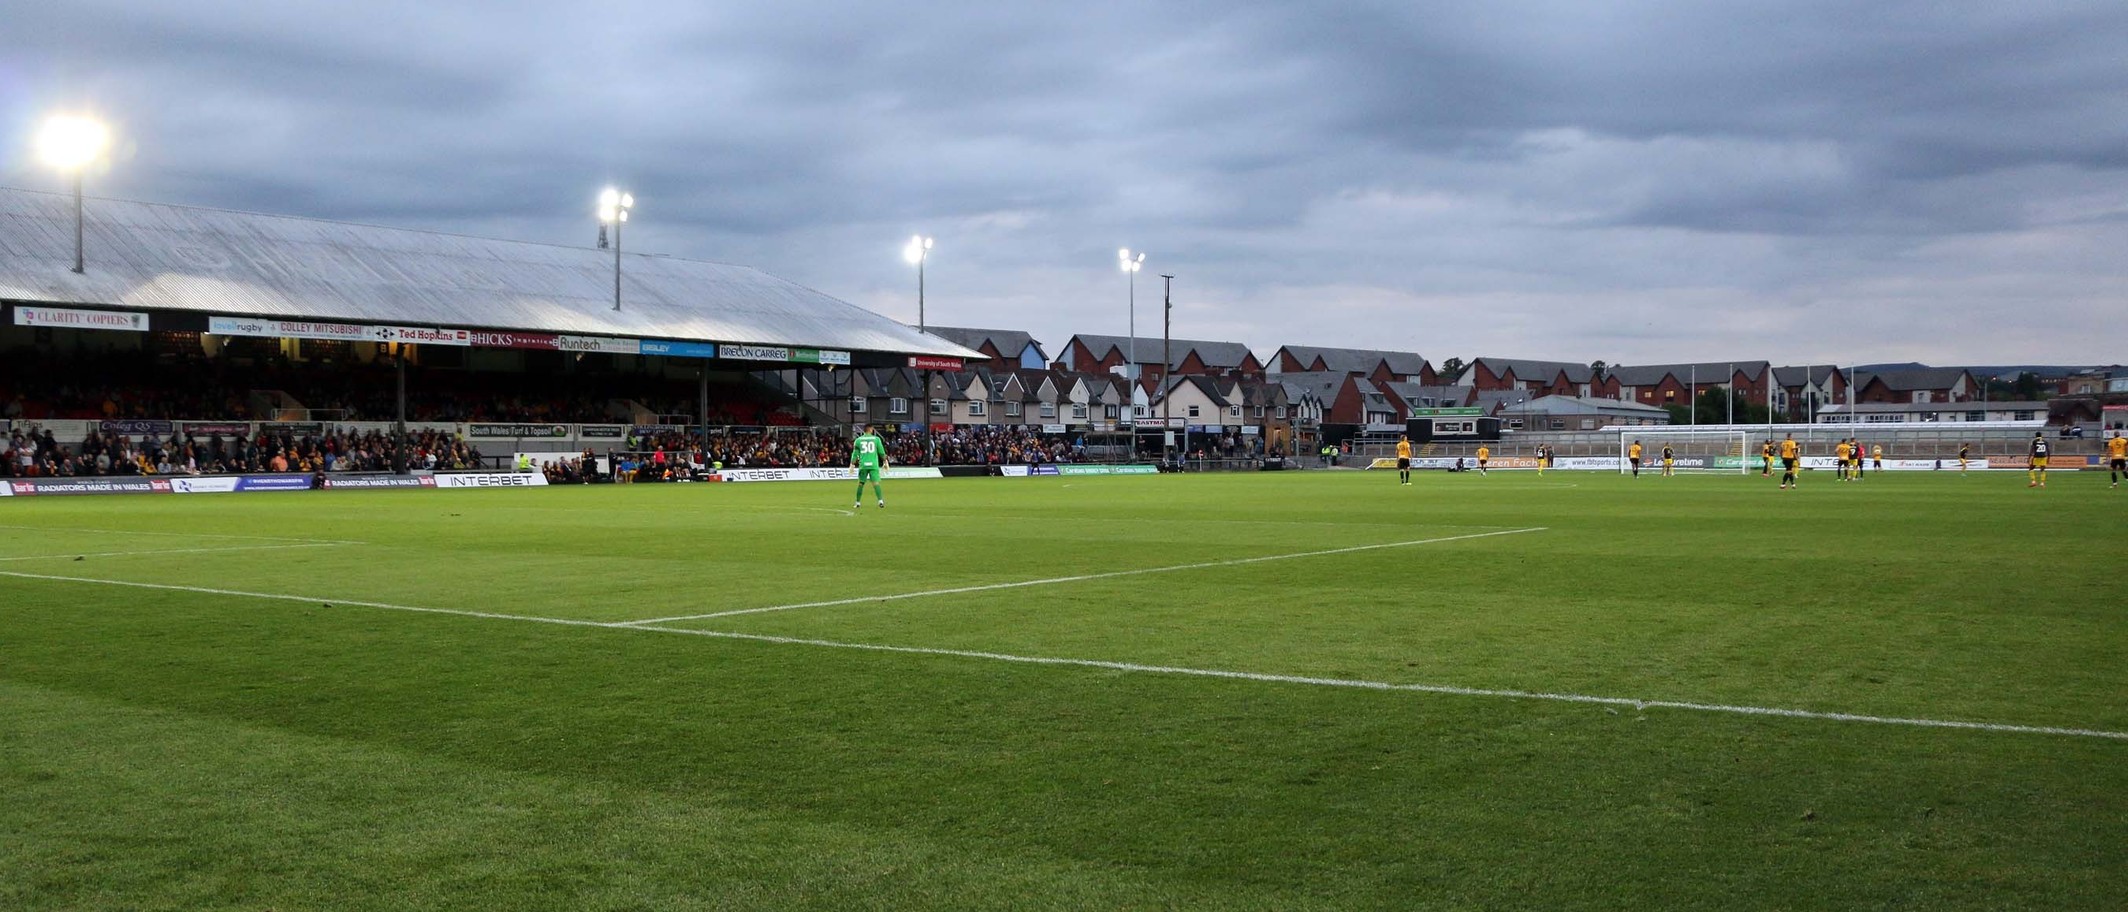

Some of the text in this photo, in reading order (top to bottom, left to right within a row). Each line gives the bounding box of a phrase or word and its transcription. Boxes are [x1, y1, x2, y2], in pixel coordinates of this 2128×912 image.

[37, 310, 129, 325] CLARITY COPIERS
[280, 322, 362, 335] COLLEY MITSUBISHI
[398, 329, 453, 341] Ted Hopkins
[476, 333, 513, 346] HICKS
[560, 336, 600, 351] Runtech
[721, 347, 753, 358] BRECON
[754, 349, 786, 359] CARREG
[101, 421, 131, 432] Coleg
[134, 421, 153, 432] QS
[471, 426, 552, 437] South Wales Turf & Topsoil
[860, 441, 876, 454] 30
[2035, 444, 2047, 453] 20
[450, 475, 532, 486] INTERBET
[728, 470, 790, 480] INTERBET
[37, 484, 87, 492] RADIATORS
[122, 483, 151, 491] WALES
